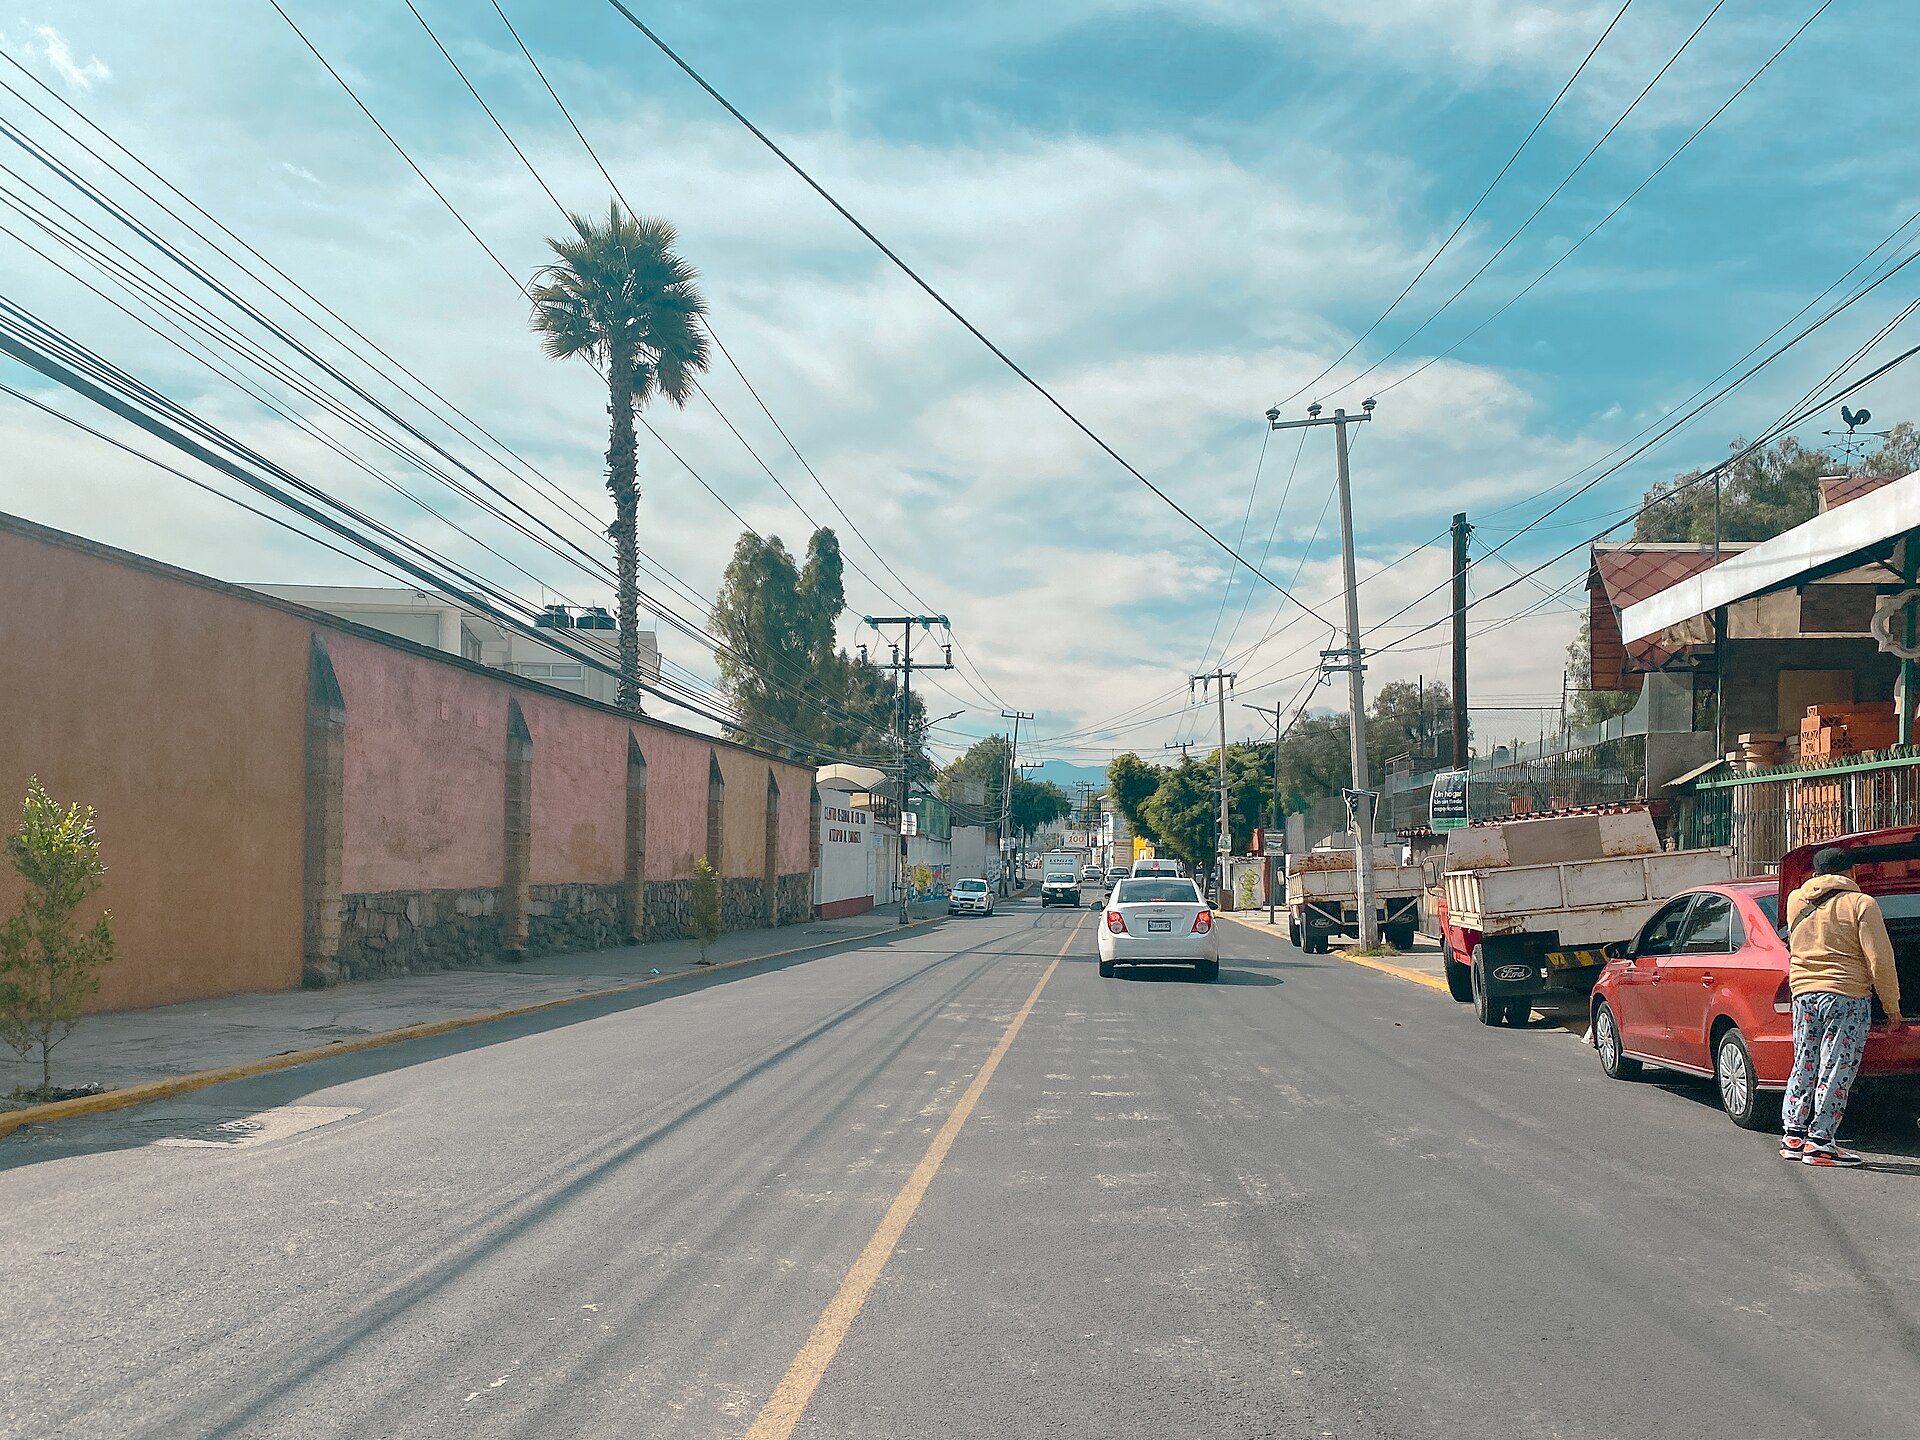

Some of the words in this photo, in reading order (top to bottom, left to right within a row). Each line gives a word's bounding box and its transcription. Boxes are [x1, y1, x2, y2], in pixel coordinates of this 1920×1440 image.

[1444, 791, 1463, 799] hogar
[1068, 835, 1085, 843] 100
[1500, 967, 1525, 979] Ford
